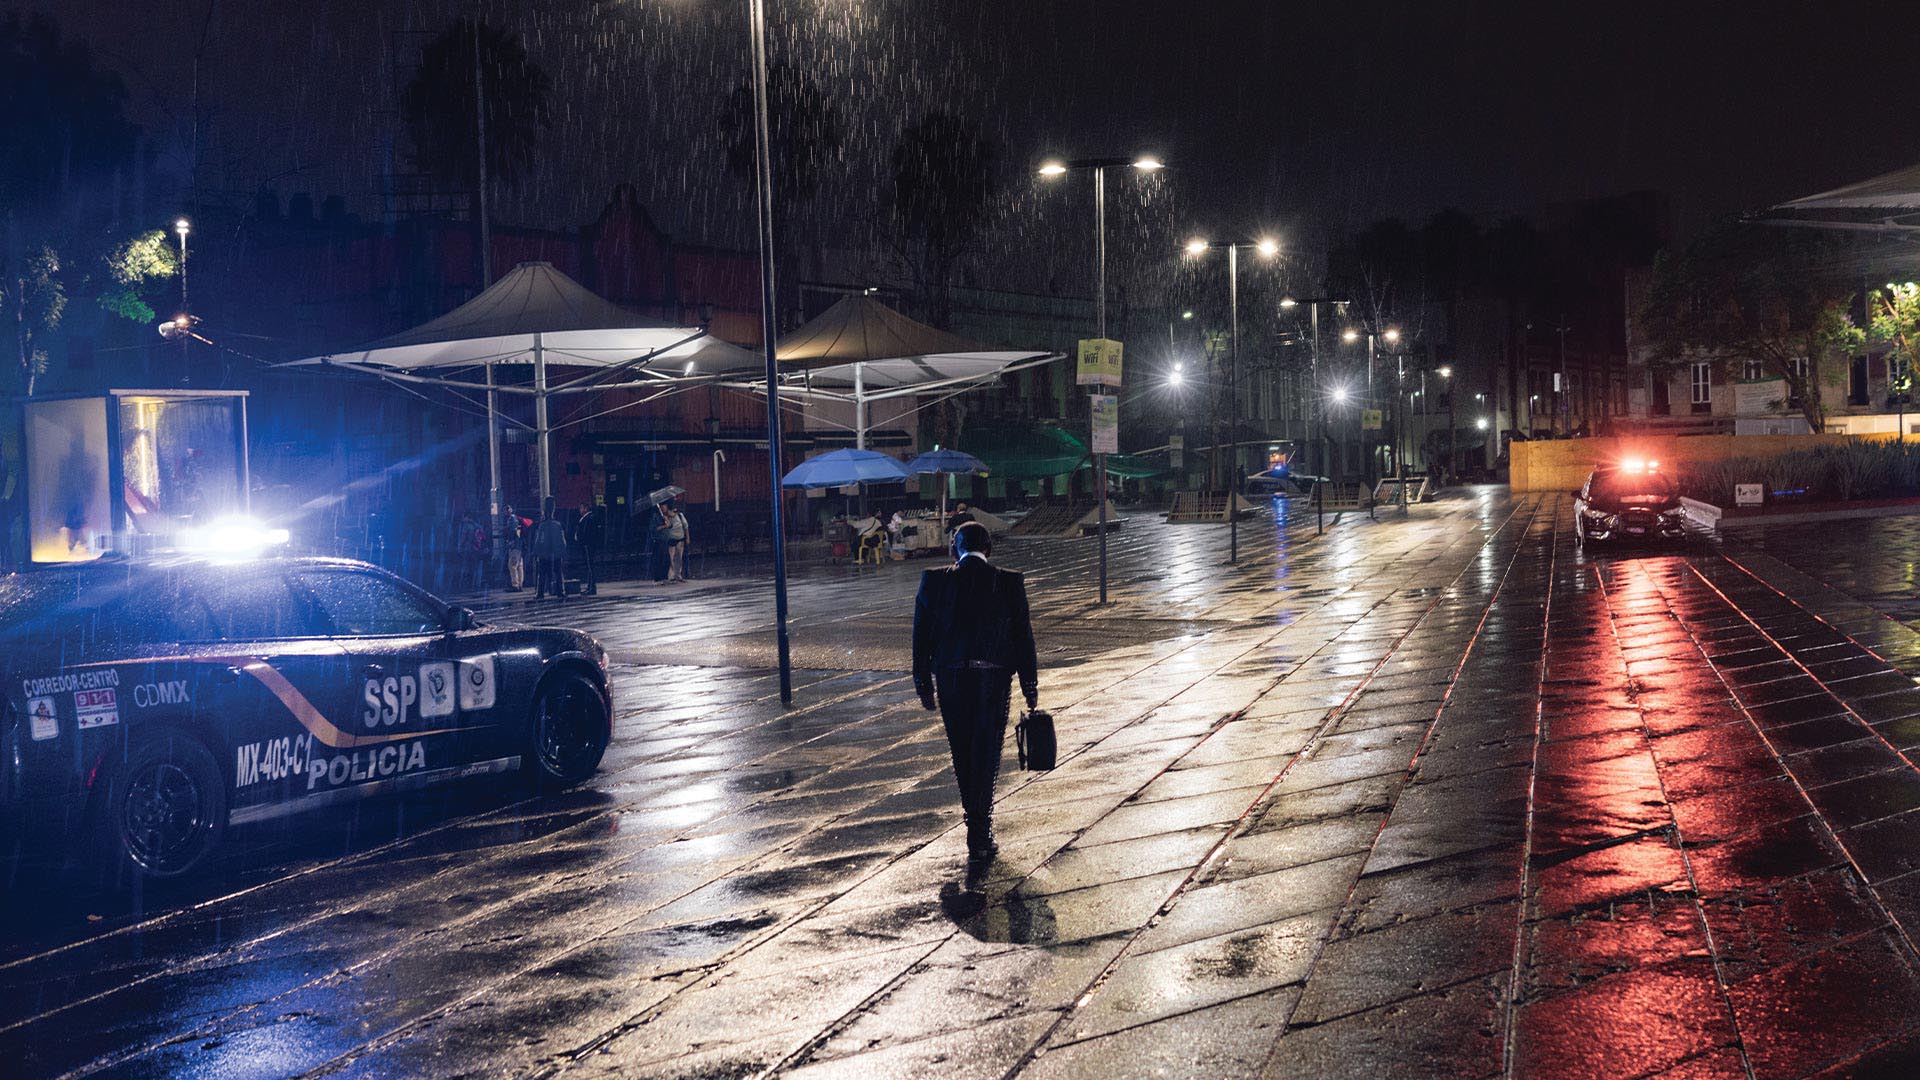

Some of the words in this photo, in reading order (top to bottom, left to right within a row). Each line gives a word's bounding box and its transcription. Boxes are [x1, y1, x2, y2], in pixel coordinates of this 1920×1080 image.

[23, 668, 119, 698] CORREDOR-CENTRO
[134, 680, 190, 708] CDMX
[79, 691, 111, 706] 911
[364, 675, 416, 728] SSP
[307, 741, 426, 790] POLICIA
